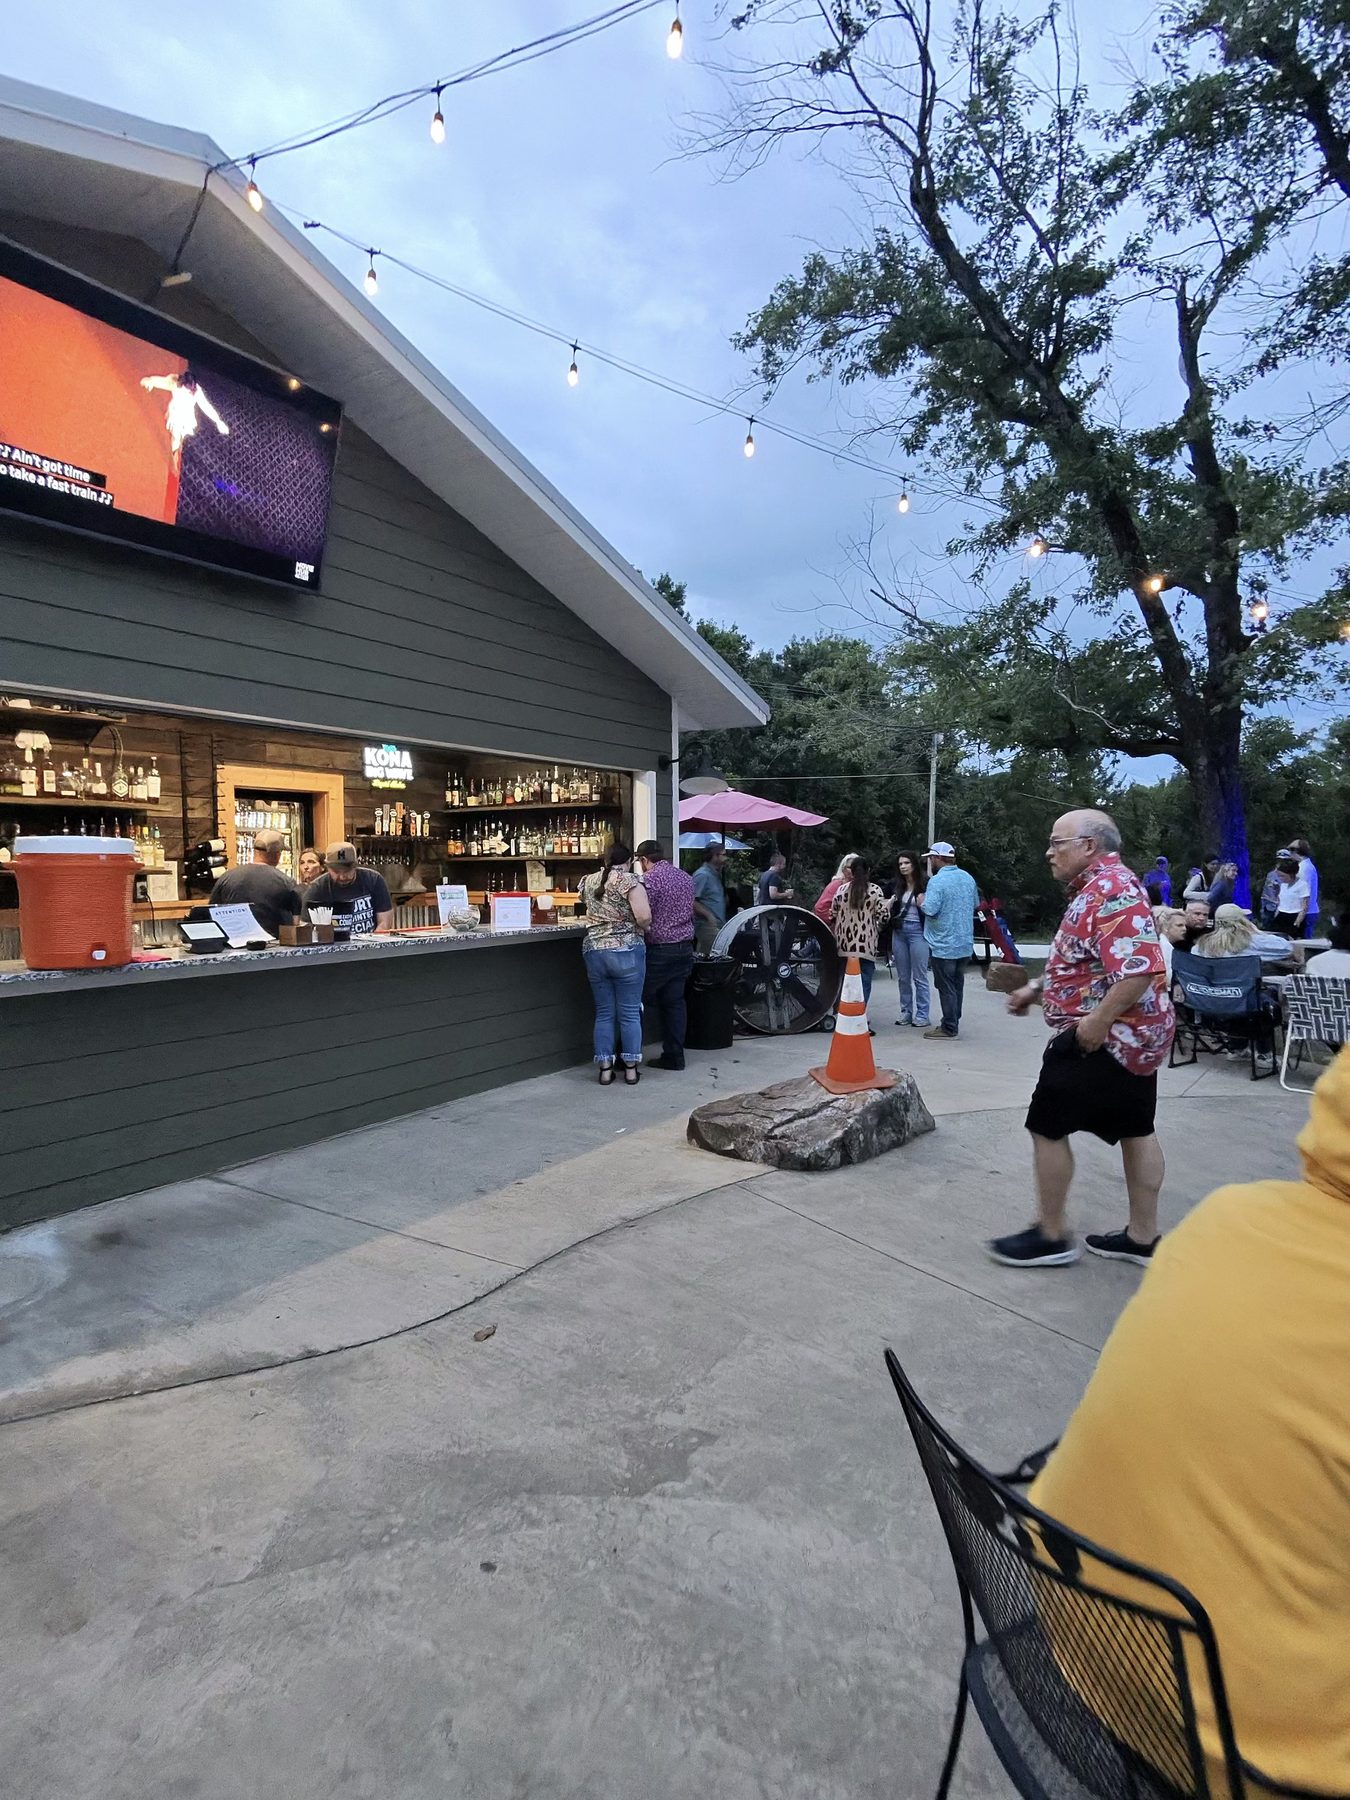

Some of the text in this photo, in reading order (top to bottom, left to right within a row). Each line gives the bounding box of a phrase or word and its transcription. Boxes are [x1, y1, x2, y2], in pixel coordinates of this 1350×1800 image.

[0, 463, 98, 501] o take a fast train
[12, 448, 91, 482] Ain't got time
[365, 747, 412, 768] KONA
